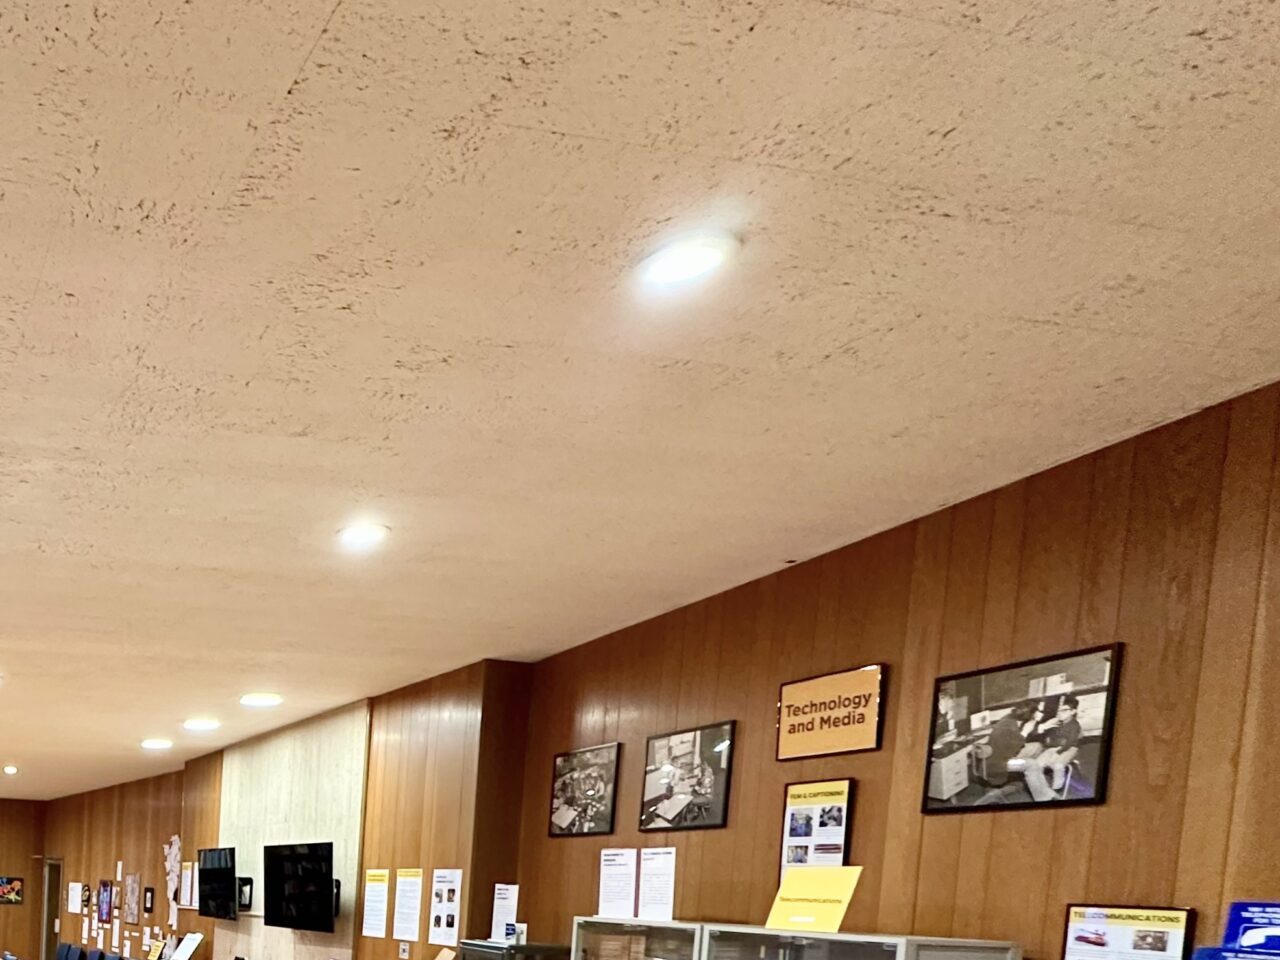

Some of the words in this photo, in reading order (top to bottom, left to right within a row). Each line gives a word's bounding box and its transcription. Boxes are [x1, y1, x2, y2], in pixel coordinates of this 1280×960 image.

[785, 693, 872, 718] Technology
[788, 717, 815, 734] and
[819, 711, 865, 730] Media
[1073, 911, 1182, 923] TELECOMMUNICATIONS
